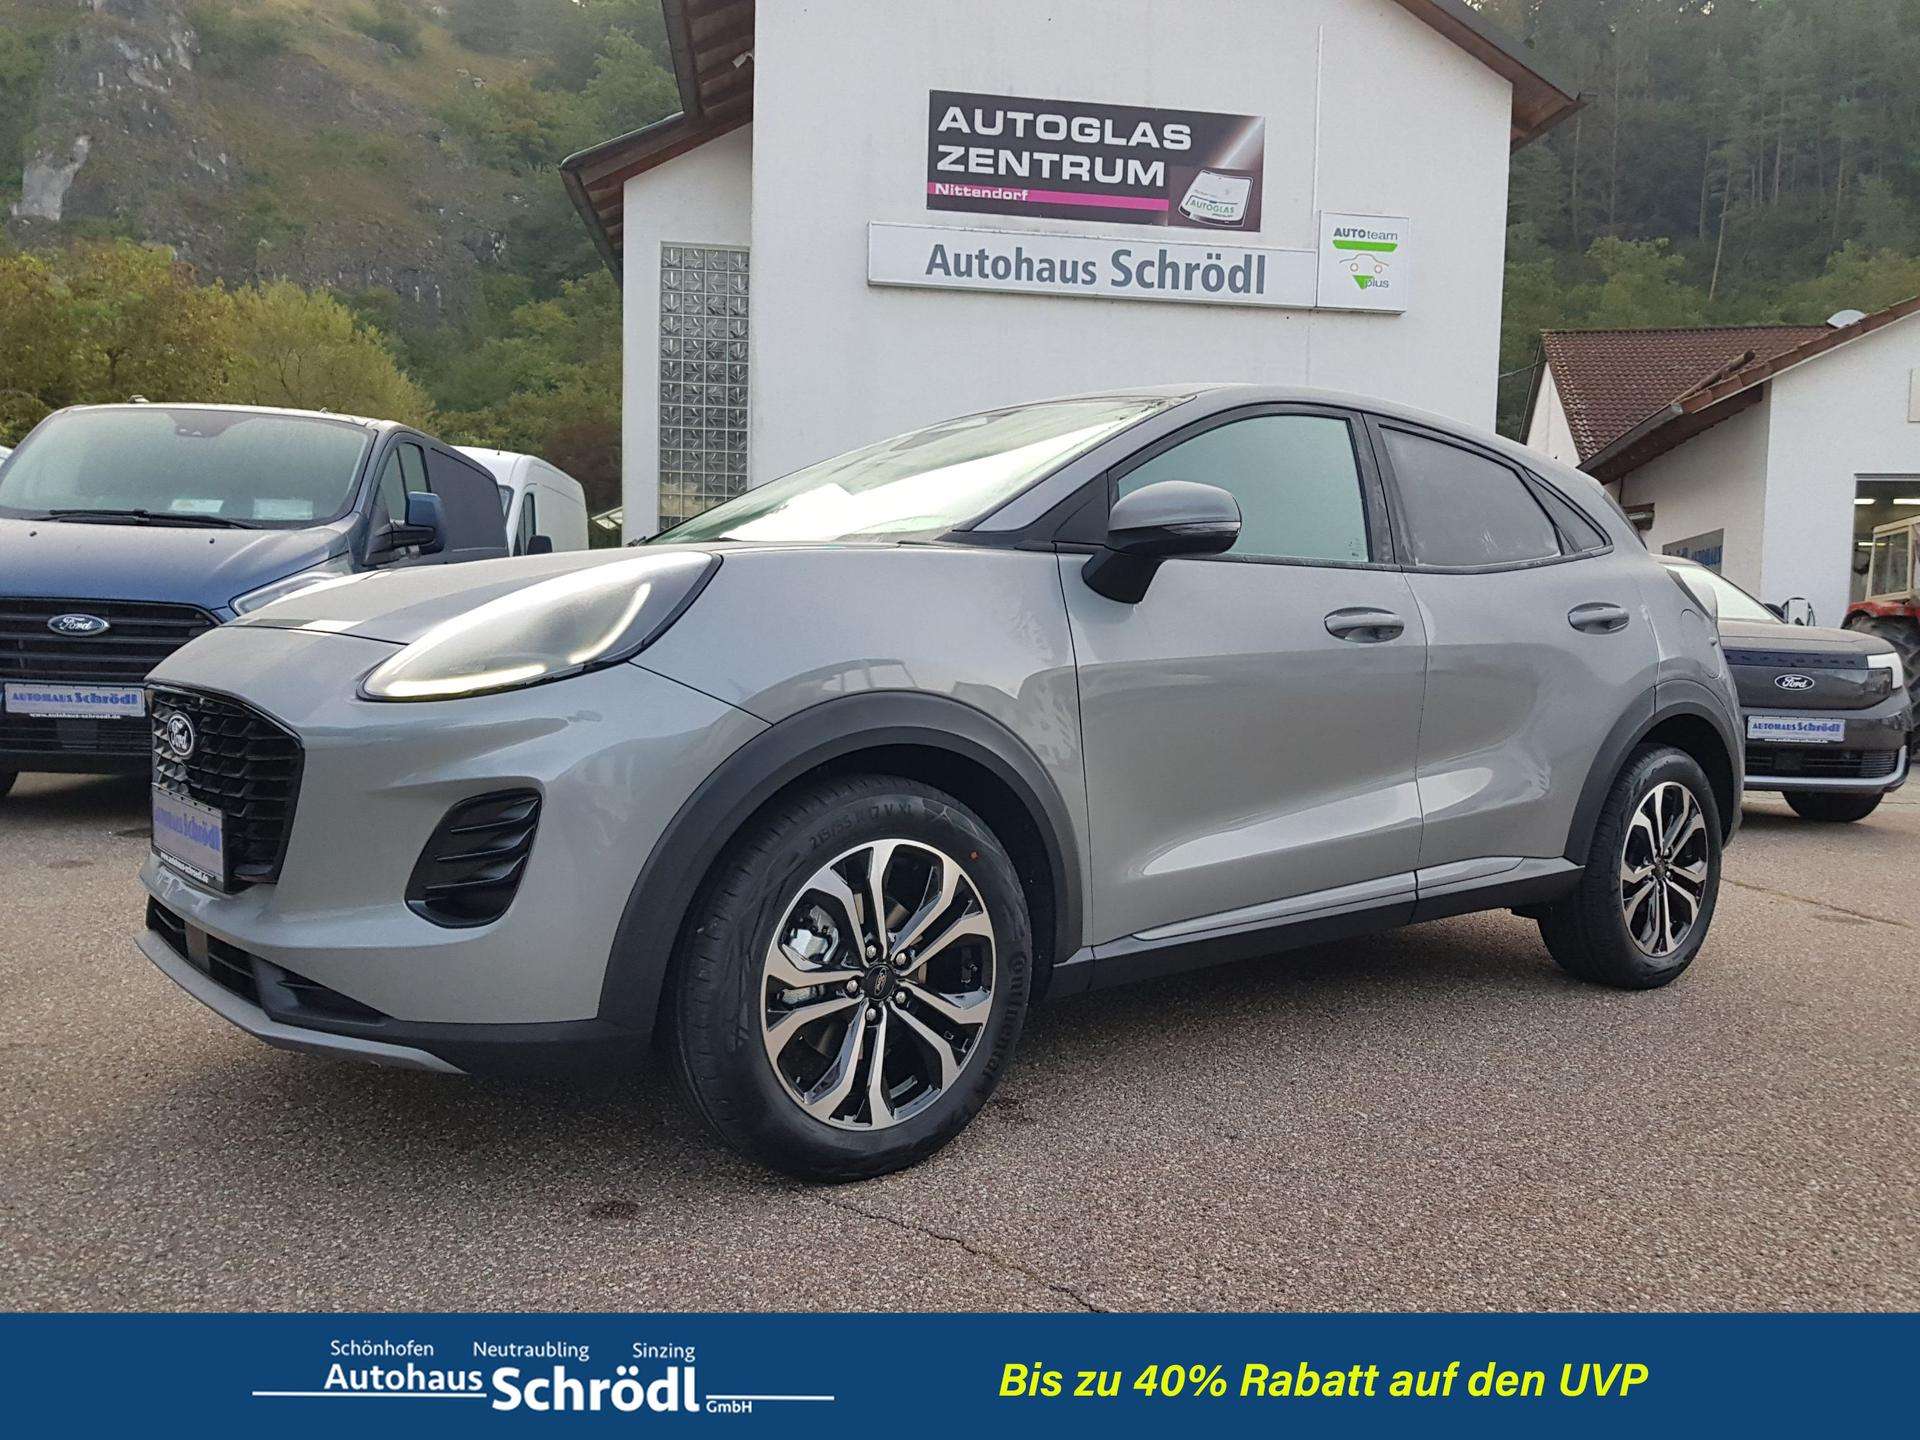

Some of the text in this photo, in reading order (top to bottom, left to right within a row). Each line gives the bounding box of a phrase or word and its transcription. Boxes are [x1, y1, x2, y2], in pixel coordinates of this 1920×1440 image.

[937, 106, 1191, 151] AUTOGLAS
[937, 144, 1165, 187] ZENTRUM
[935, 183, 1029, 202] Nittendorf
[1190, 200, 1235, 213] AUTOGLAS
[925, 243, 1266, 295] Autohaus Schrödl
[1365, 280, 1390, 289] plus
